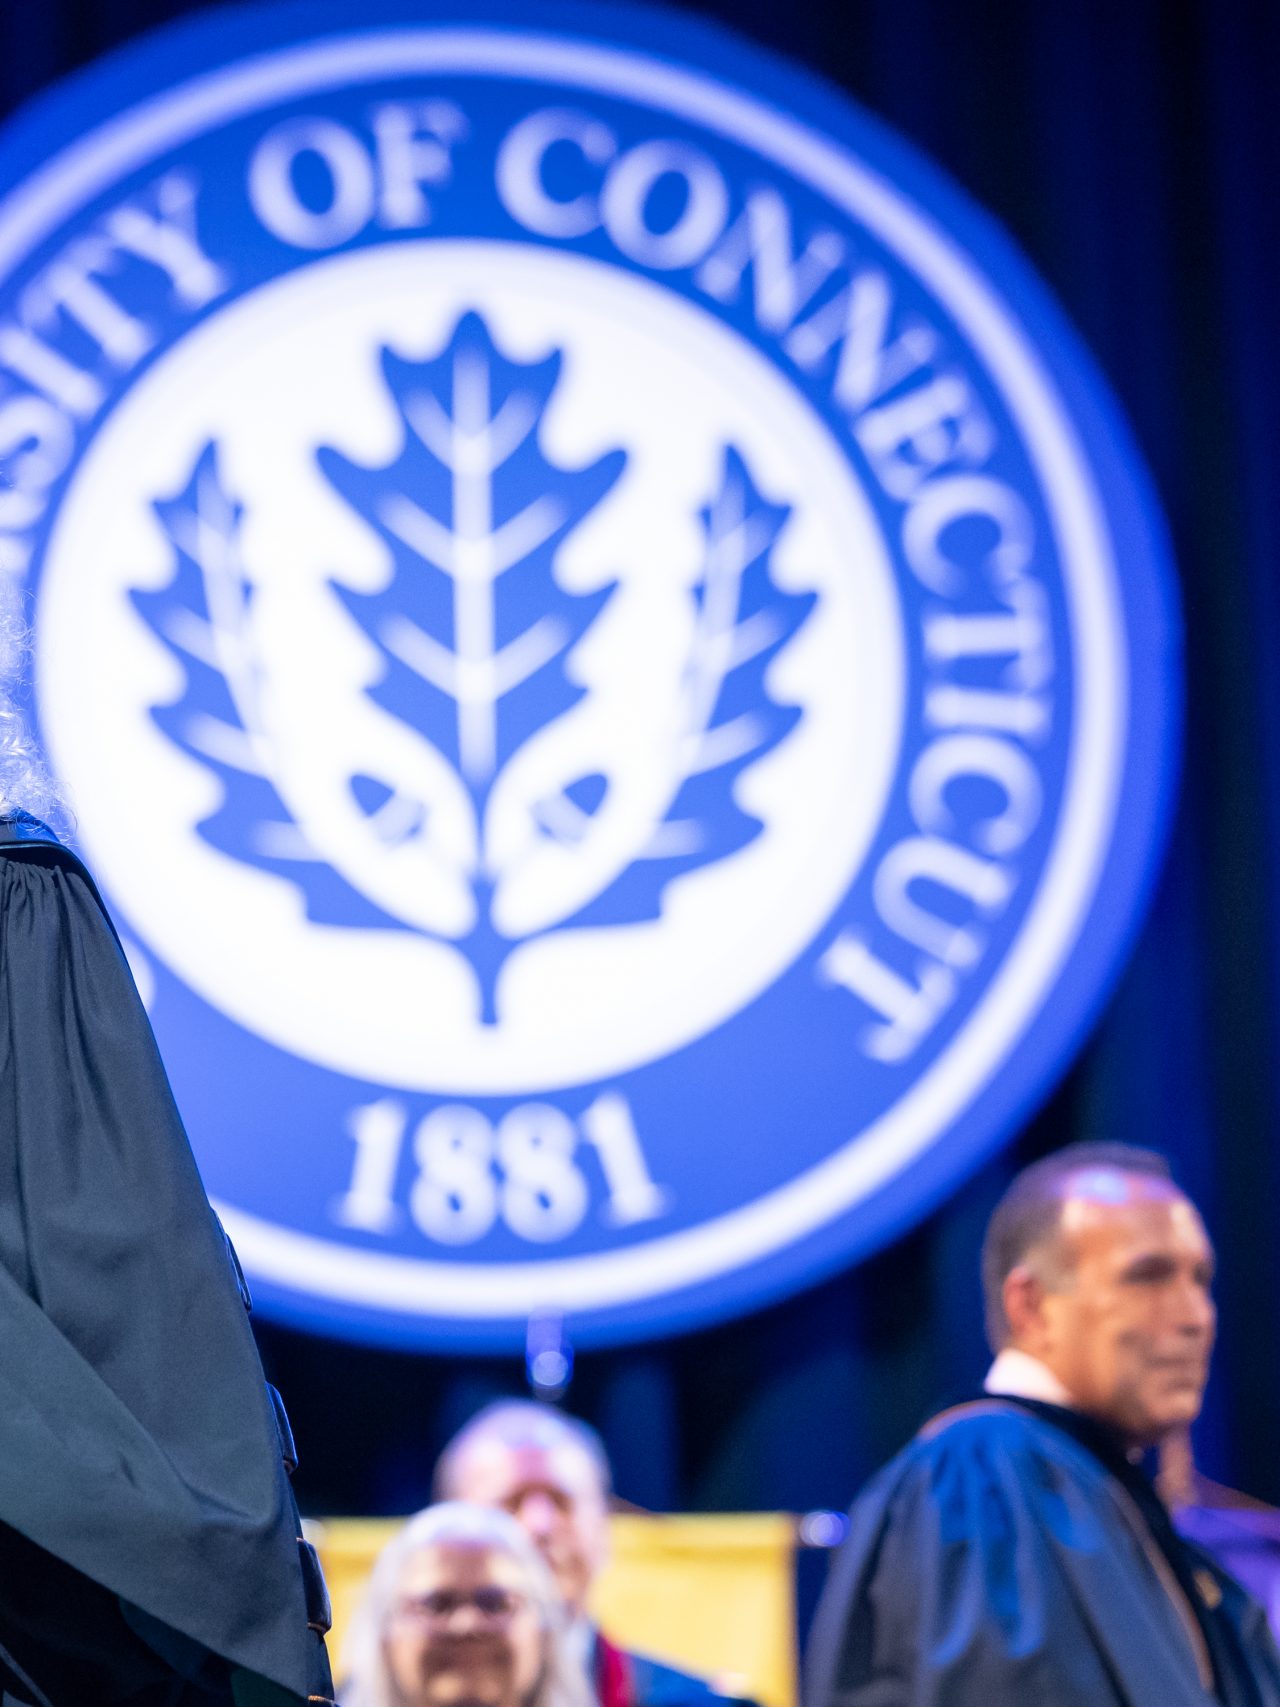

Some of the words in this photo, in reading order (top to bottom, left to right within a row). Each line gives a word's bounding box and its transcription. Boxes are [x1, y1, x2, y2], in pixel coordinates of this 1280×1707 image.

[247, 100, 466, 249] OF
[496, 107, 1053, 1064] CONNECTICUT
[332, 1093, 669, 1245] 1881
